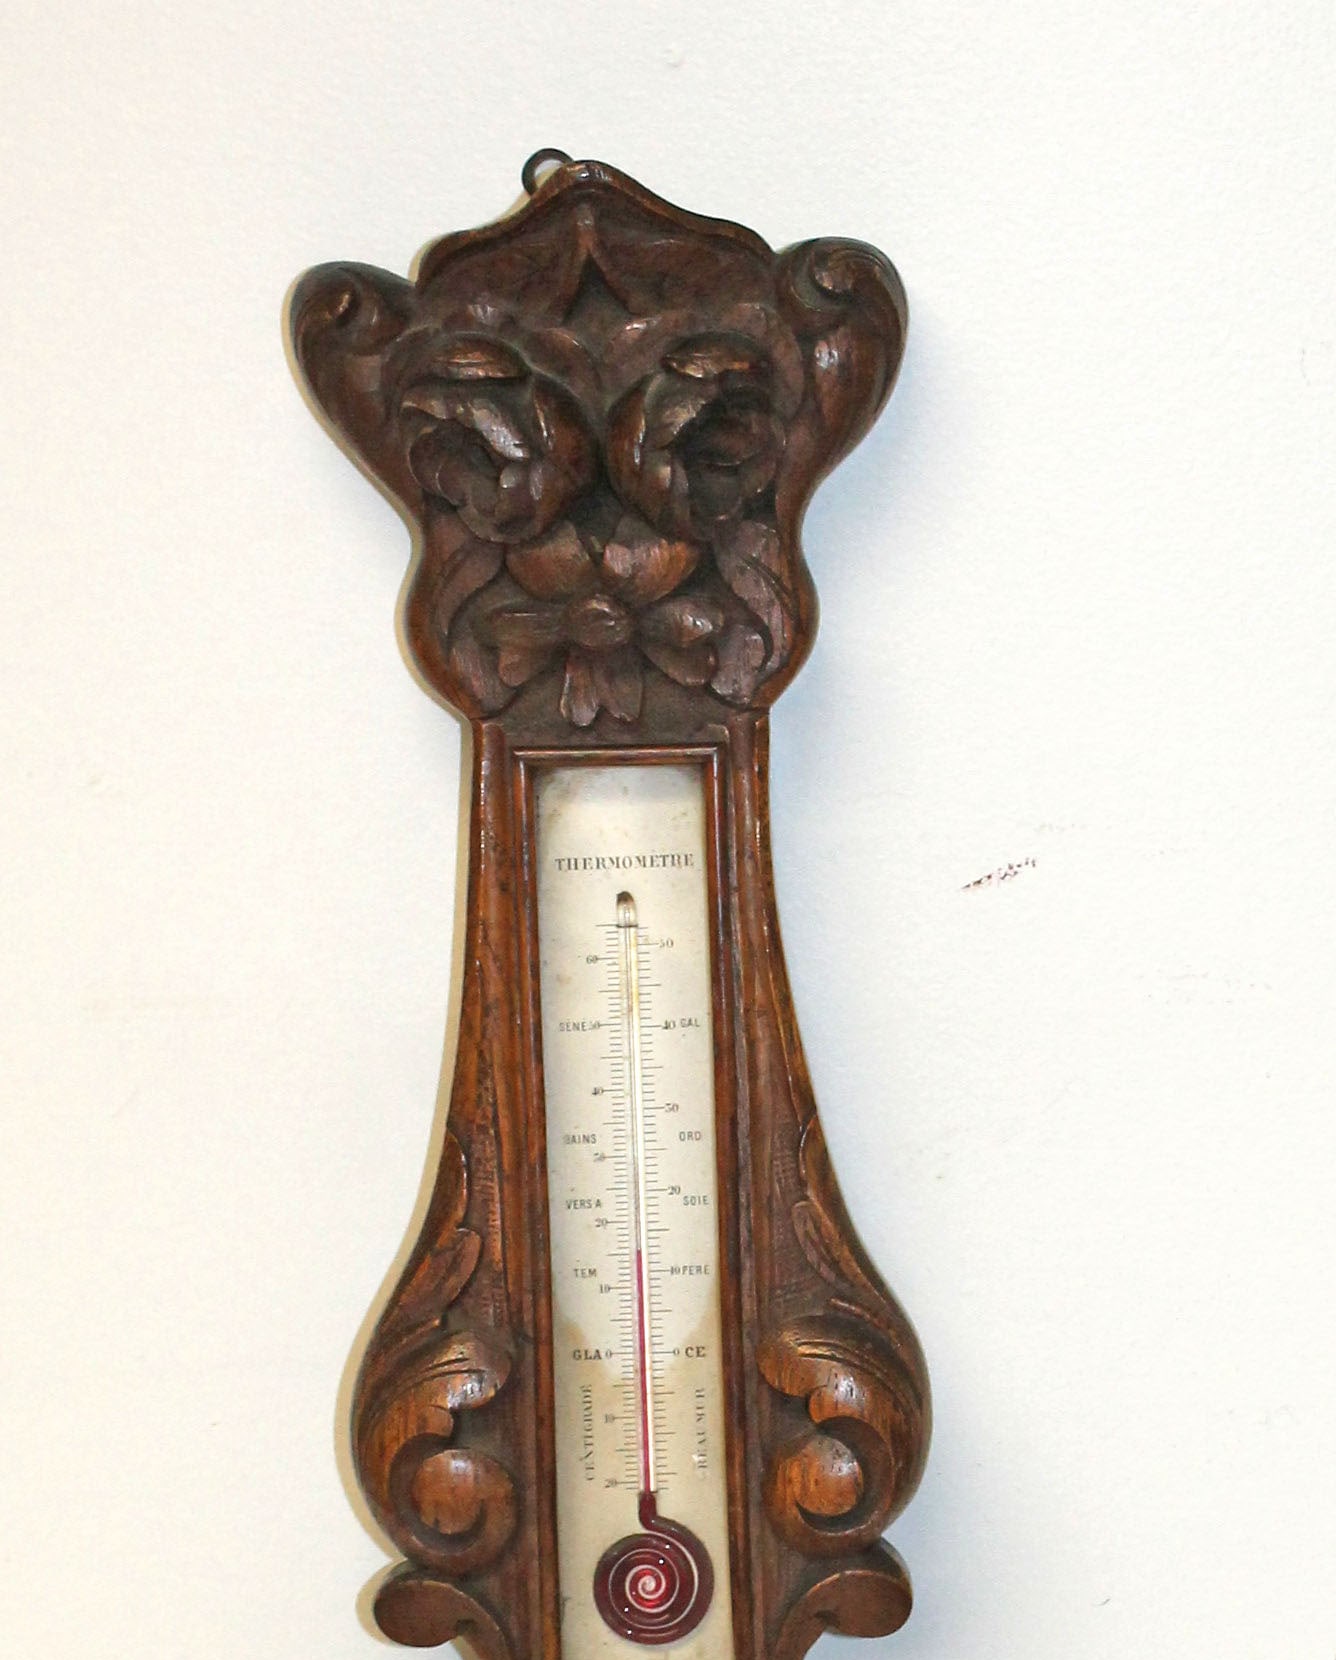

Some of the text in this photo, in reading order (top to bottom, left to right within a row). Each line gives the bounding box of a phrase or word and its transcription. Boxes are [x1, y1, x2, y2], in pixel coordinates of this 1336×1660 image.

[679, 1131, 702, 1141] ORD
[683, 1196, 709, 1206] SOIE
[574, 1268, 597, 1278] TEM
[573, 1349, 601, 1361] GLA
[685, 1347, 707, 1358] CE
